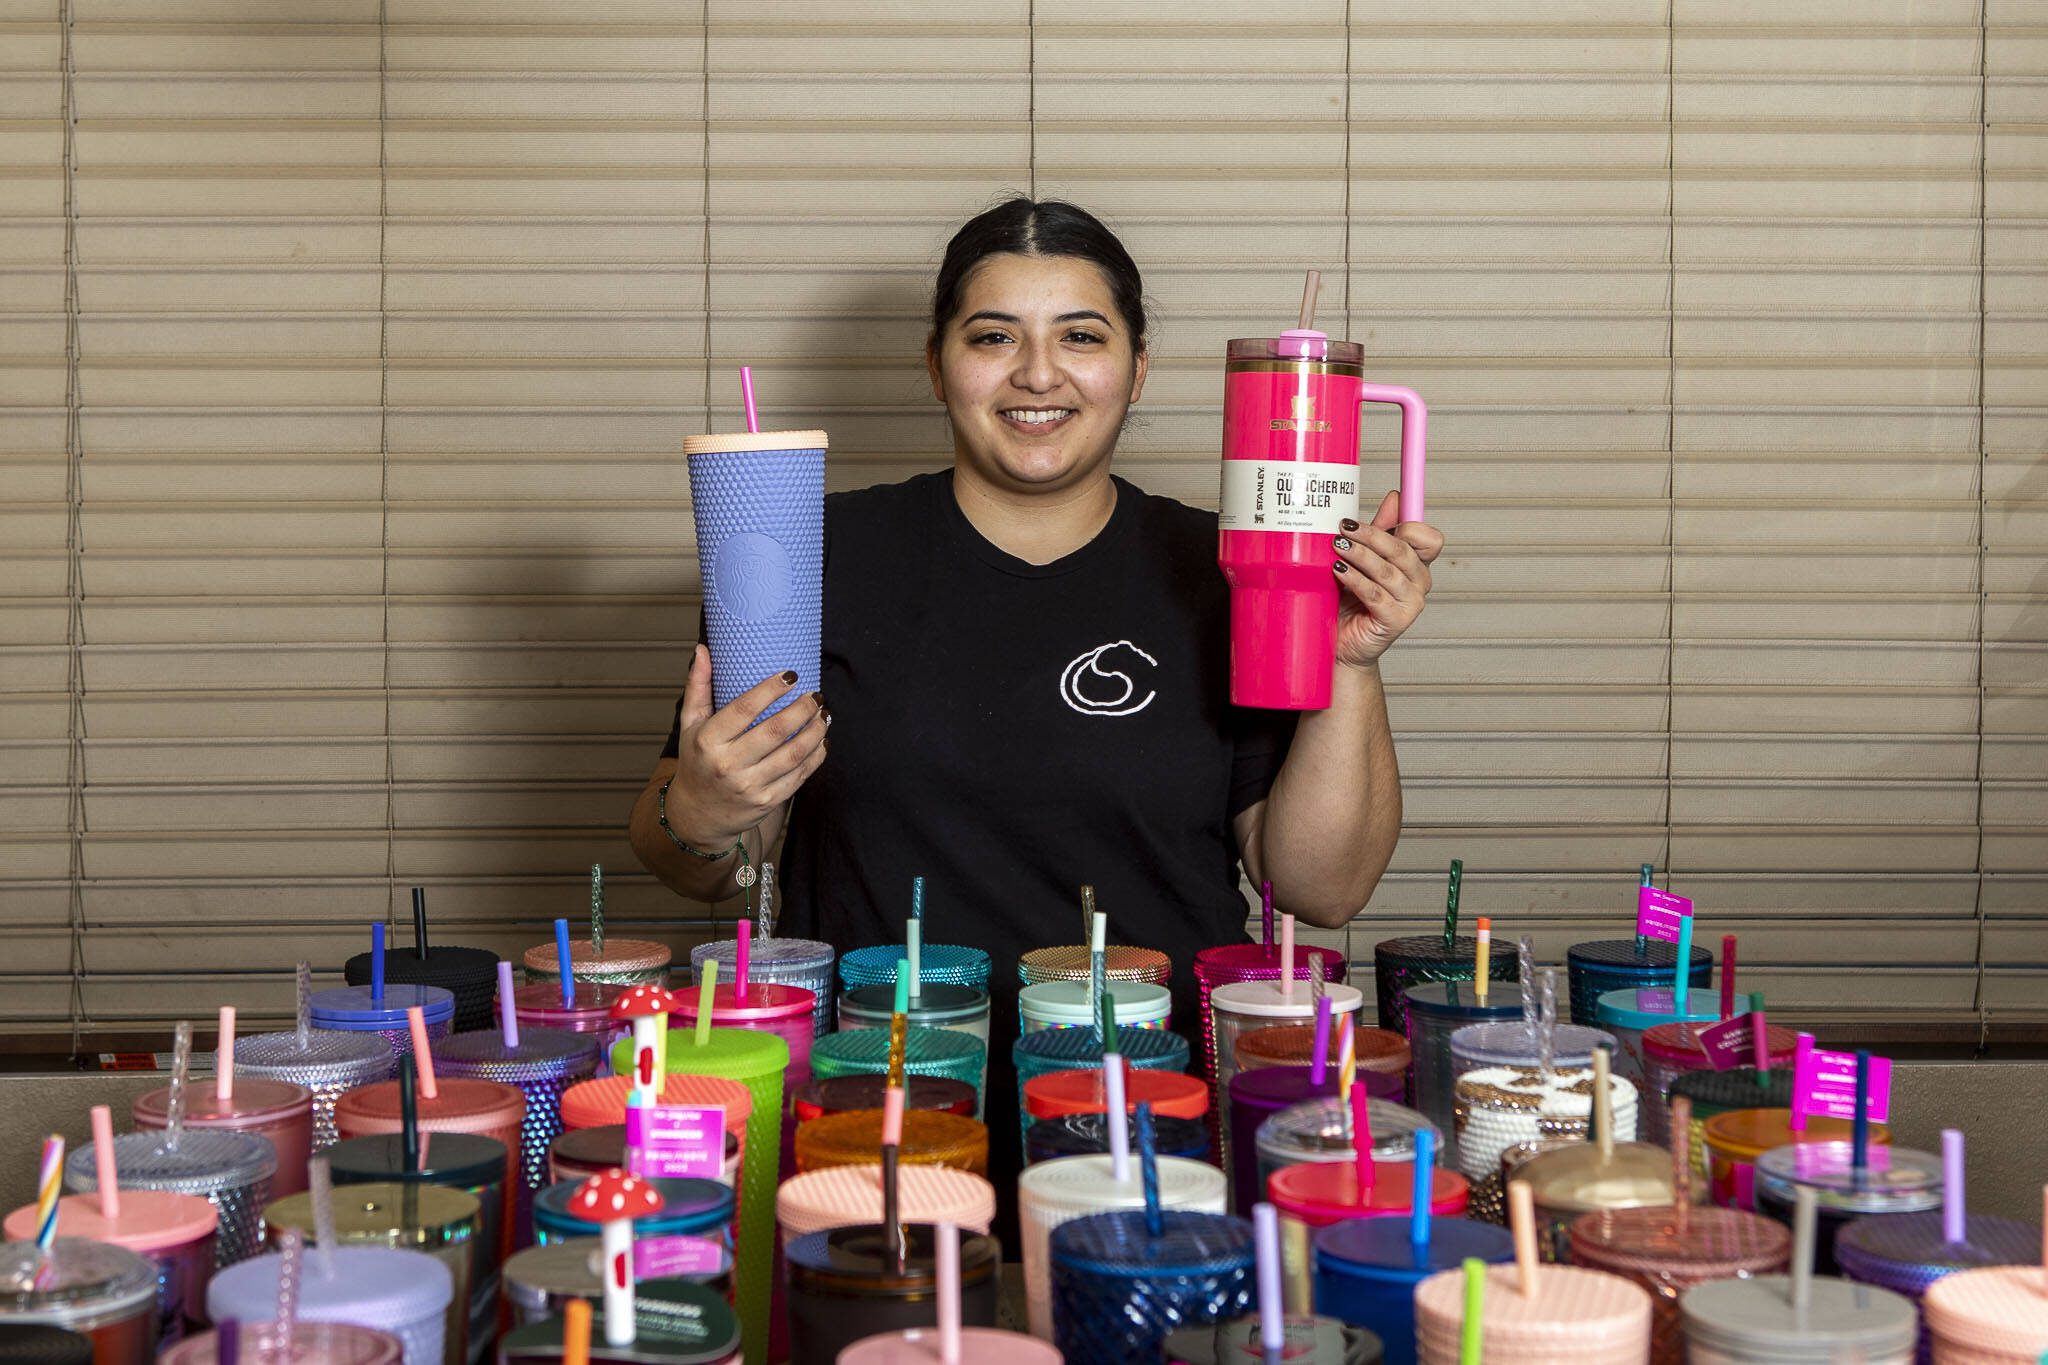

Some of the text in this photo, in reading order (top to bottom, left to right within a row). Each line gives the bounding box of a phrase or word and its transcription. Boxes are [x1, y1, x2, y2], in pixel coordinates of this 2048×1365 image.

[1270, 419, 1332, 432] STAEY
[1256, 467, 1265, 511] STANLEY
[1276, 478, 1338, 494] QUCHER
[1276, 493, 1331, 508] TUBLER
